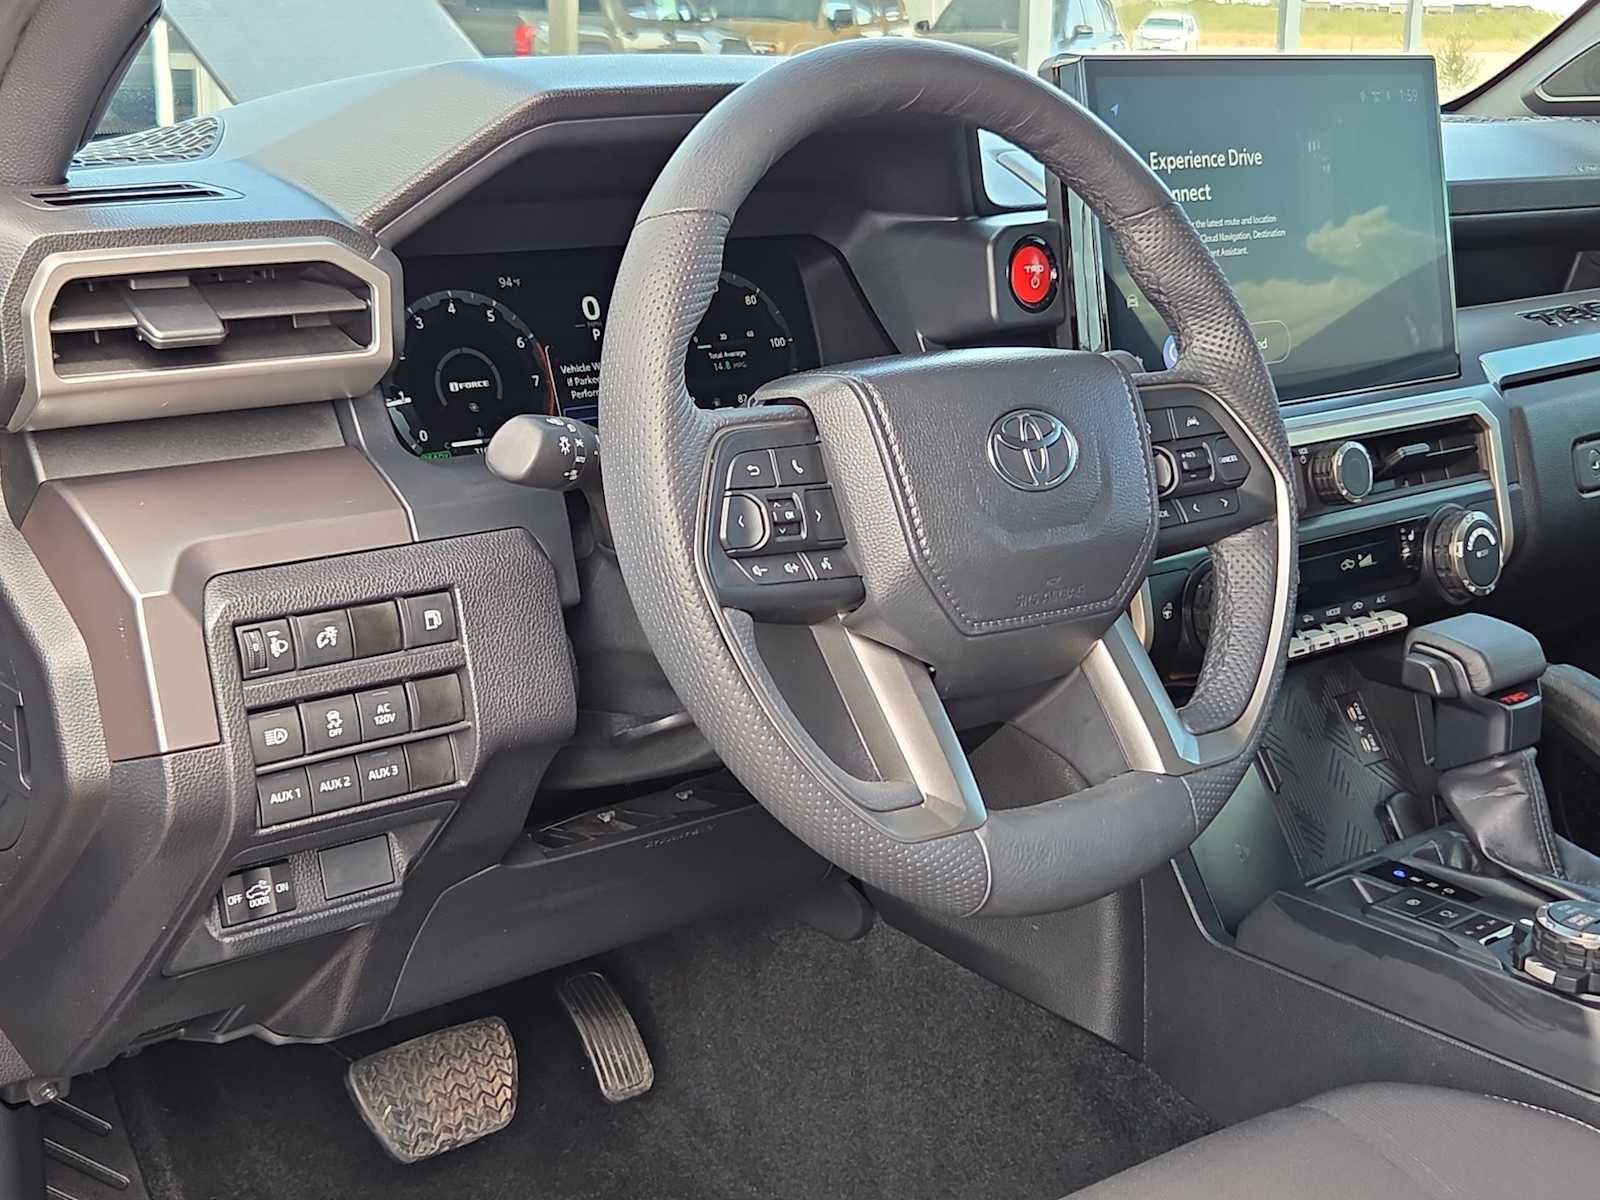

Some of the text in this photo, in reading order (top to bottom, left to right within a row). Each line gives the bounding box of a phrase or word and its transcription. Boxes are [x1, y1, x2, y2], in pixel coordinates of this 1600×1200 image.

[1149, 147, 1263, 174] Experience Drive
[1171, 184, 1212, 202] nnect
[1206, 219, 1223, 228] latest
[1224, 217, 1240, 226] route
[1241, 216, 1252, 225] and
[1253, 215, 1277, 224] location
[1253, 229, 1286, 240] Destination
[448, 302, 456, 315] 4
[582, 296, 600, 321] 0
[486, 309, 496, 323] 5
[415, 317, 425, 330] 3
[592, 328, 601, 341] P
[516, 336, 526, 349] 6
[769, 337, 787, 349] 100
[560, 362, 591, 374] Vehicle
[531, 375, 540, 388] 7
[419, 430, 428, 442] 0
[377, 703, 391, 714] AC
[374, 712, 396, 725] 120V
[328, 727, 343, 737] OFF
[367, 765, 399, 781] AUX 3
[320, 776, 352, 793] AUX 2
[270, 787, 302, 804] AUX 1
[275, 882, 289, 893] ON
[227, 893, 243, 906] OFF
